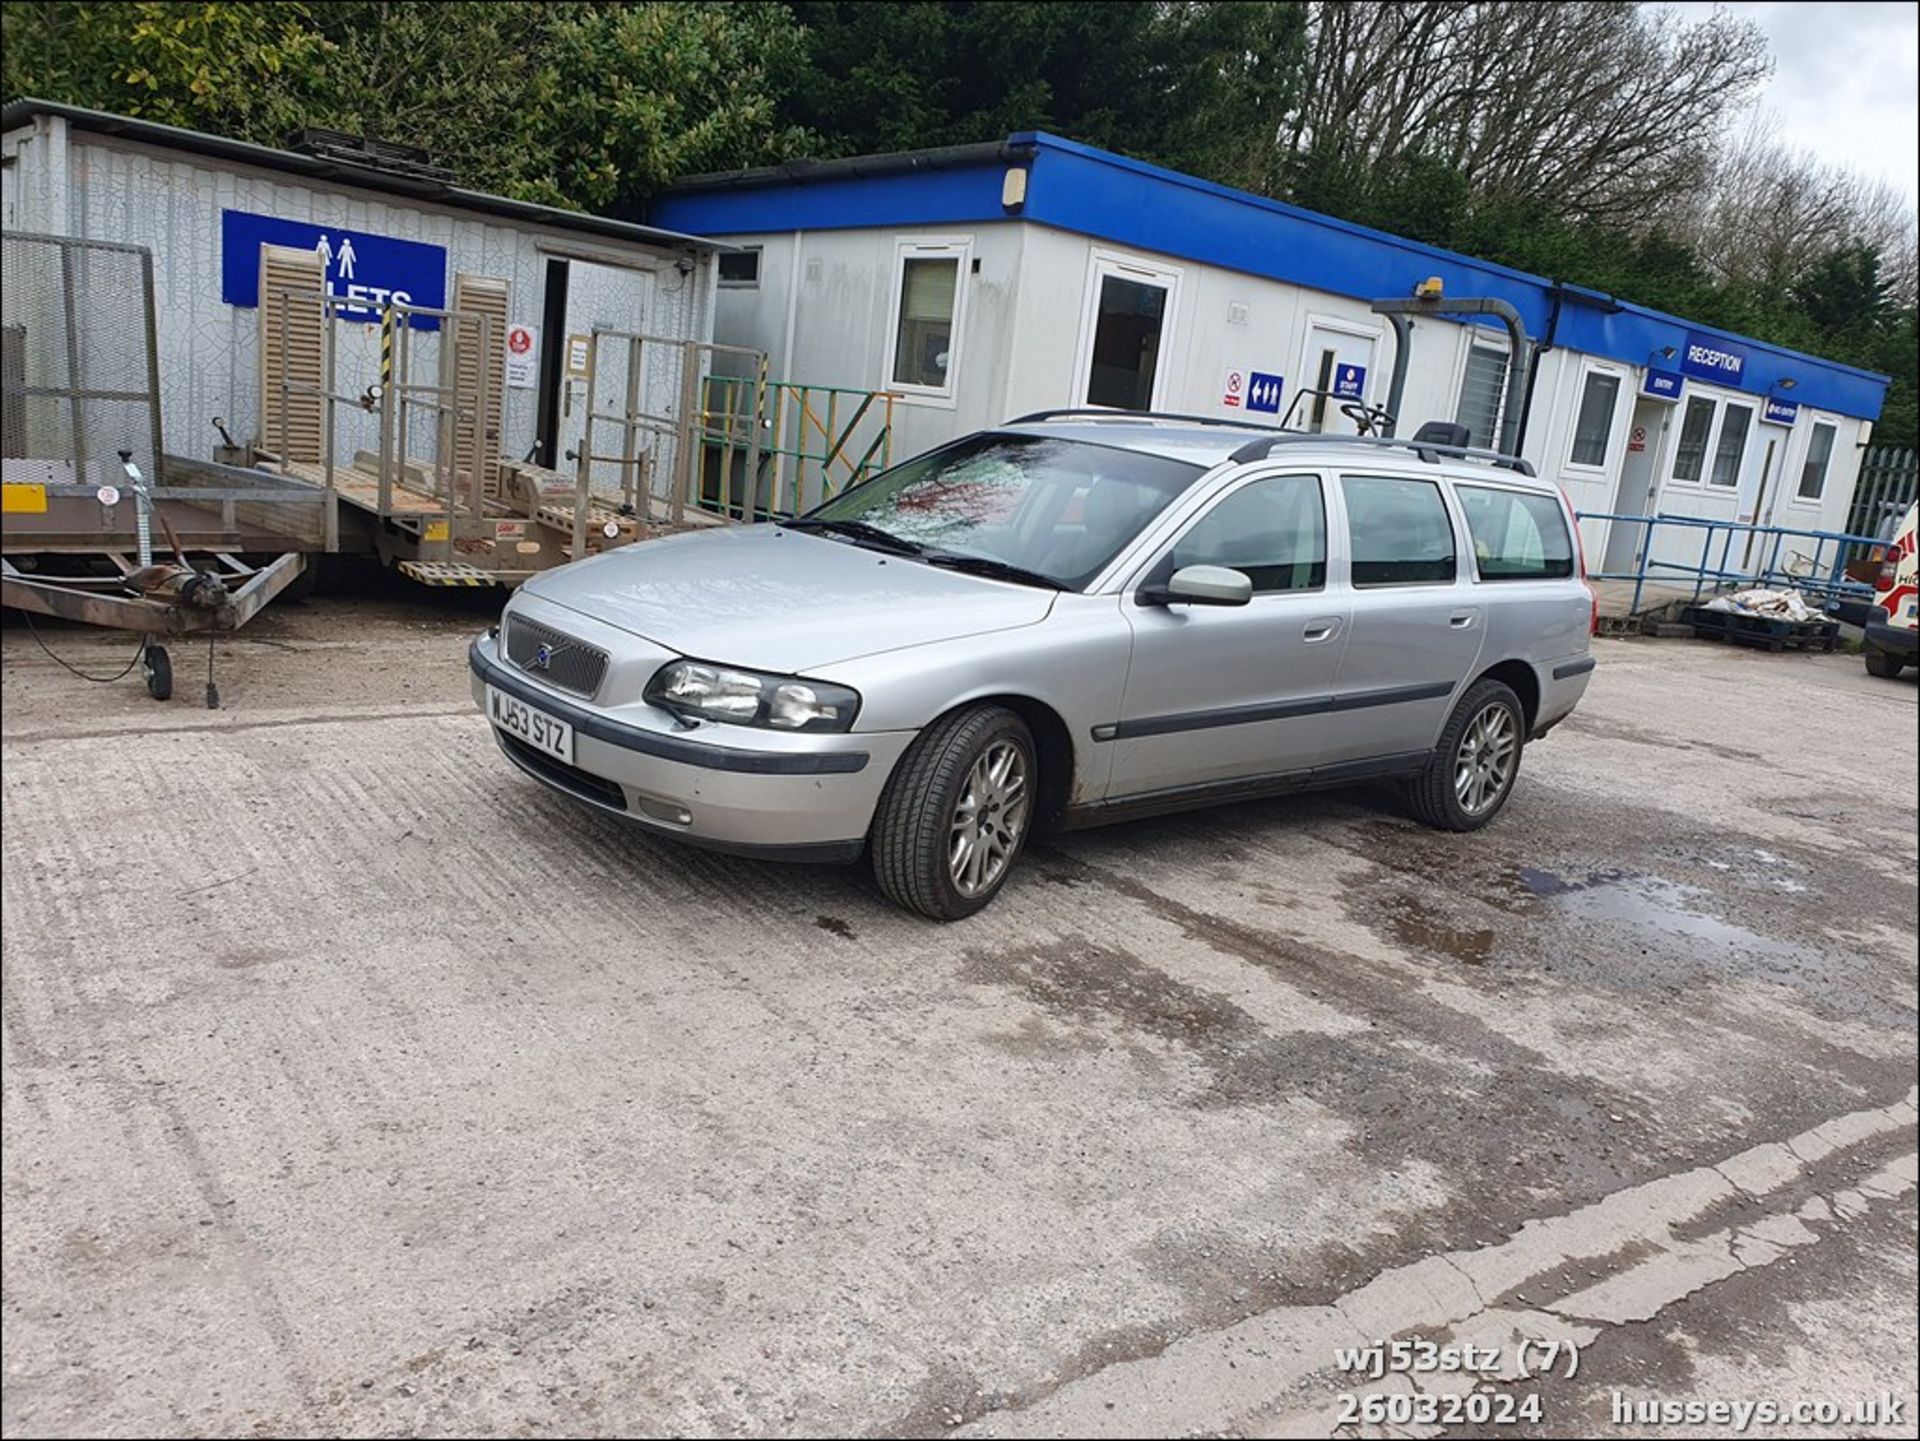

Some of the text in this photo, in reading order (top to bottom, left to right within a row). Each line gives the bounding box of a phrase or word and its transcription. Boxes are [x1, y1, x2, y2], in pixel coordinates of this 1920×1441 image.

[326, 281, 411, 319] LETS
[1687, 345, 1742, 373] RECEPTION
[1653, 377, 1674, 390] ENTRY
[491, 689, 565, 755] WJ53 STZ
